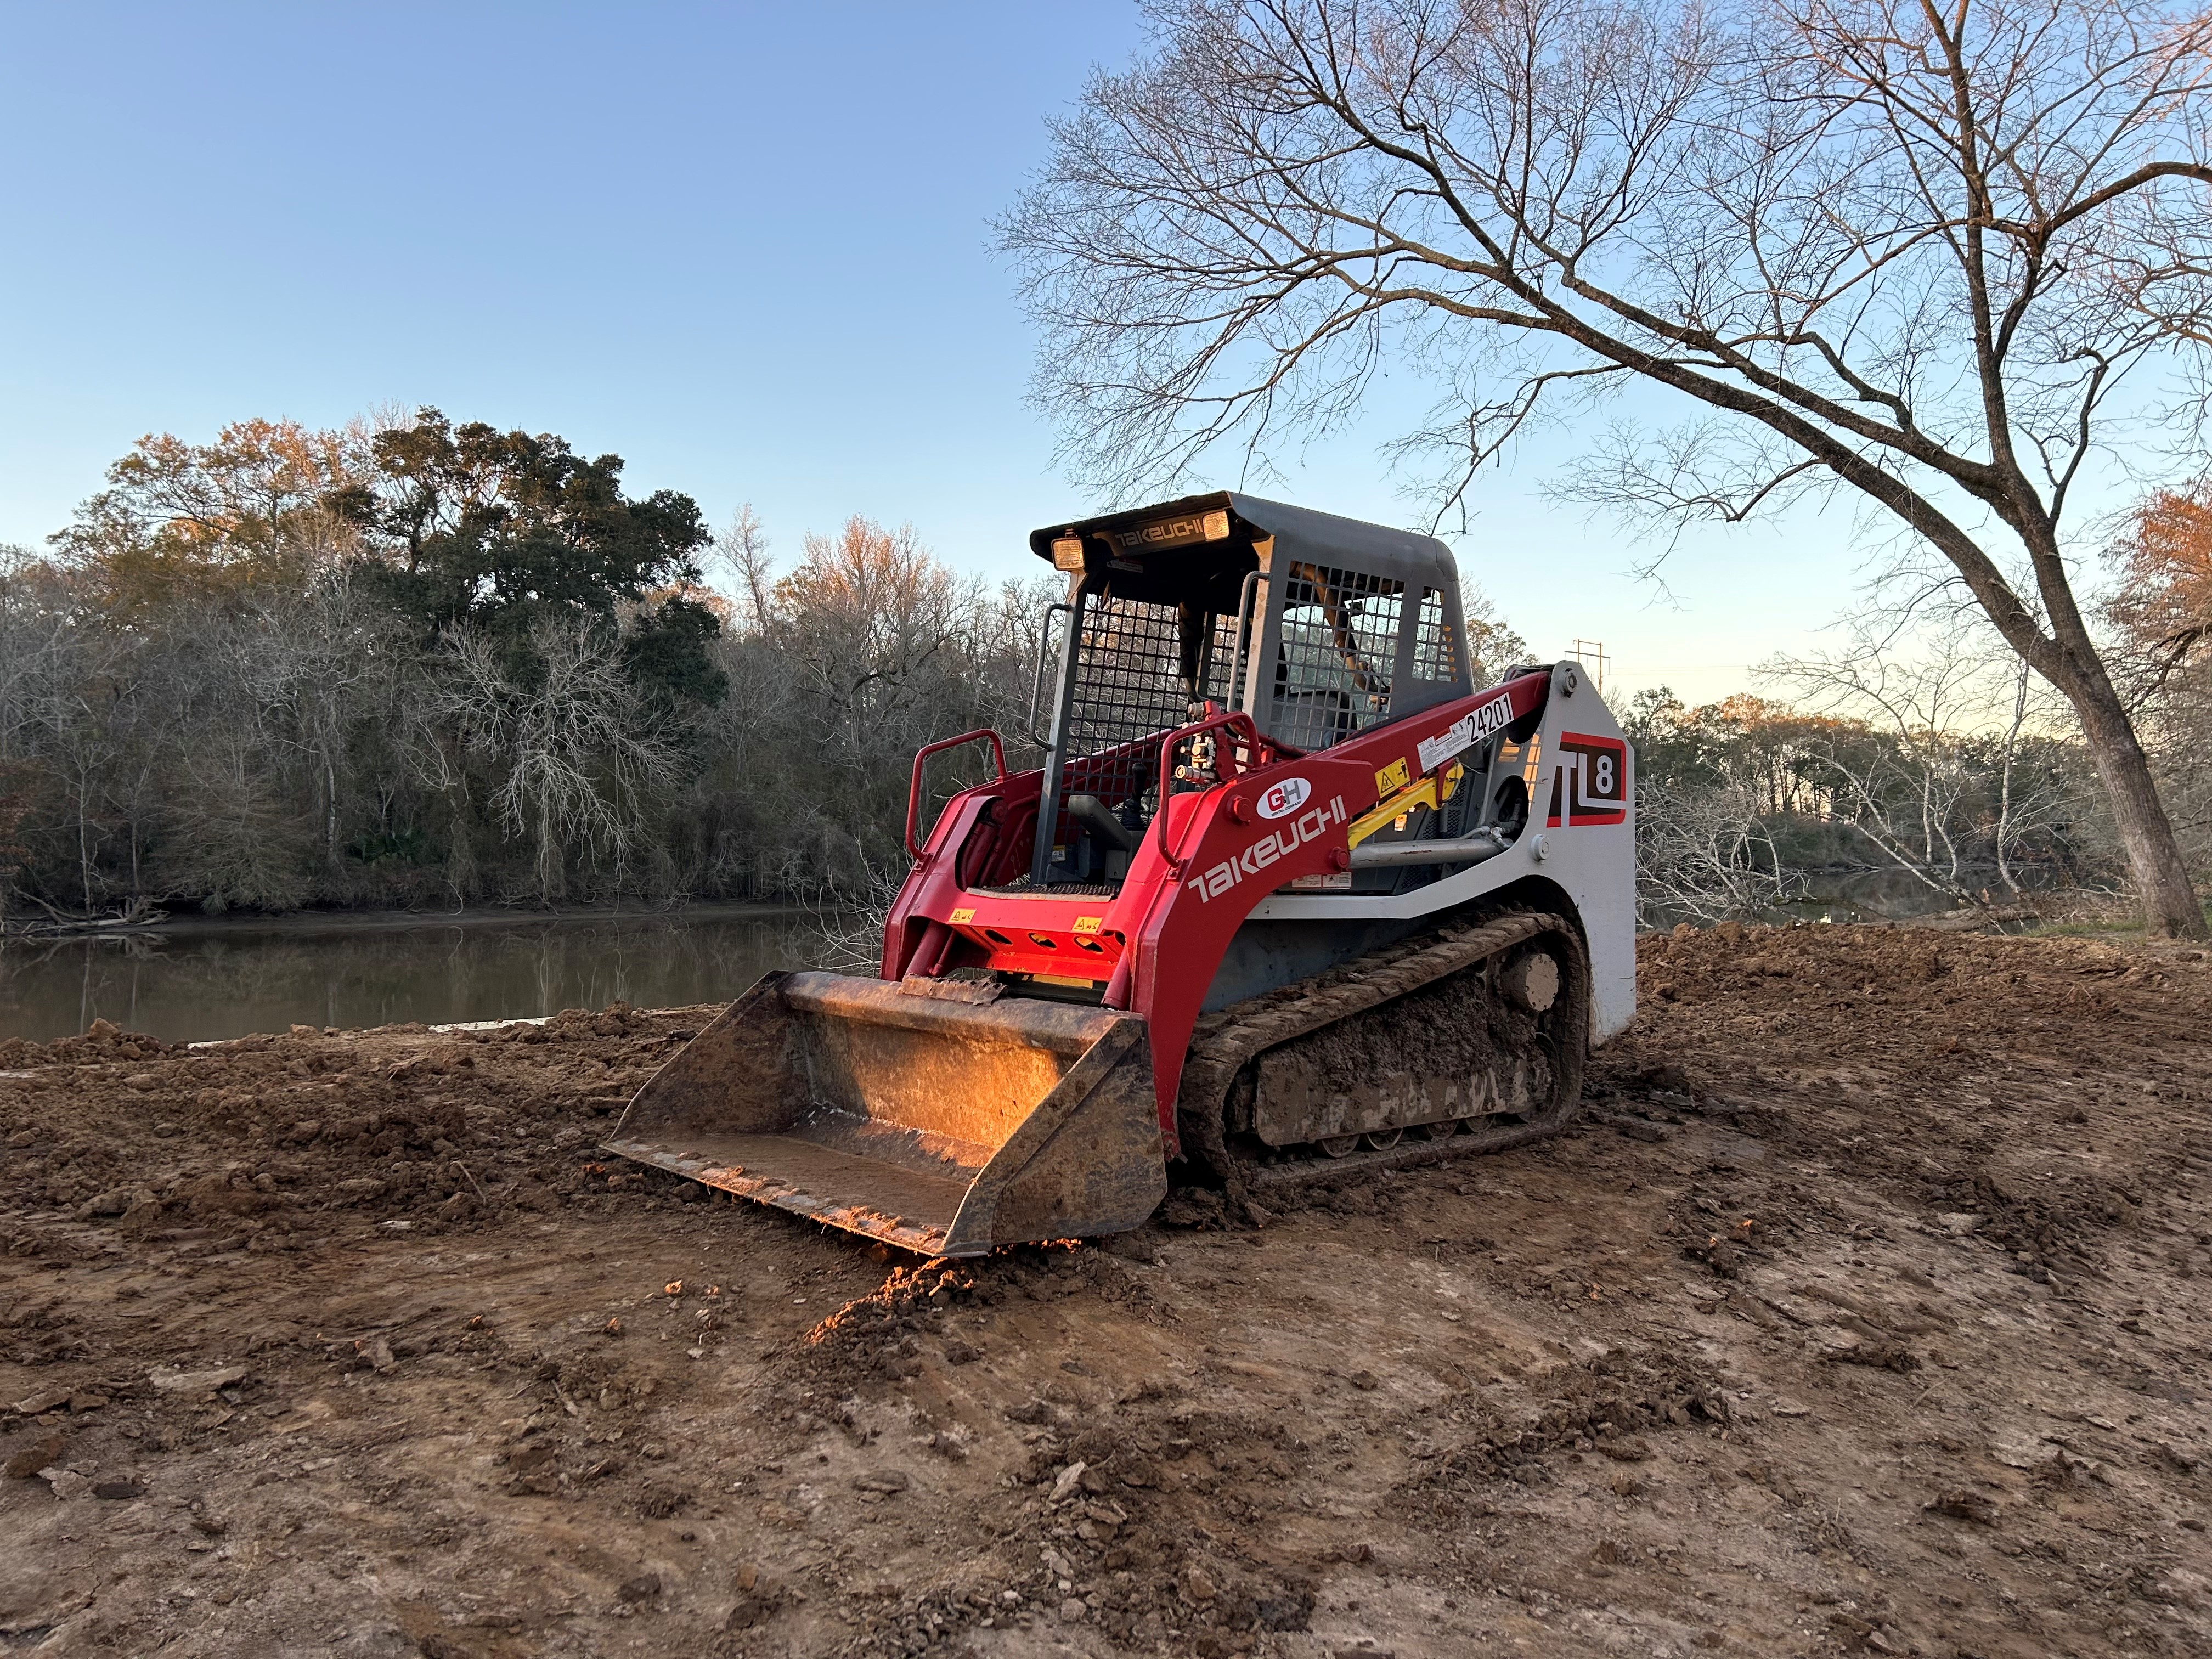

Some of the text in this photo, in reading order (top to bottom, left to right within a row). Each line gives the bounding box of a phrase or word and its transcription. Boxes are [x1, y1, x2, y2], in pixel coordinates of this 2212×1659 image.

[1467, 695, 1512, 743] 24201
[1271, 800, 1302, 817] RENTAL COMPANY
[1188, 794, 1347, 904] TAKEUCHI
